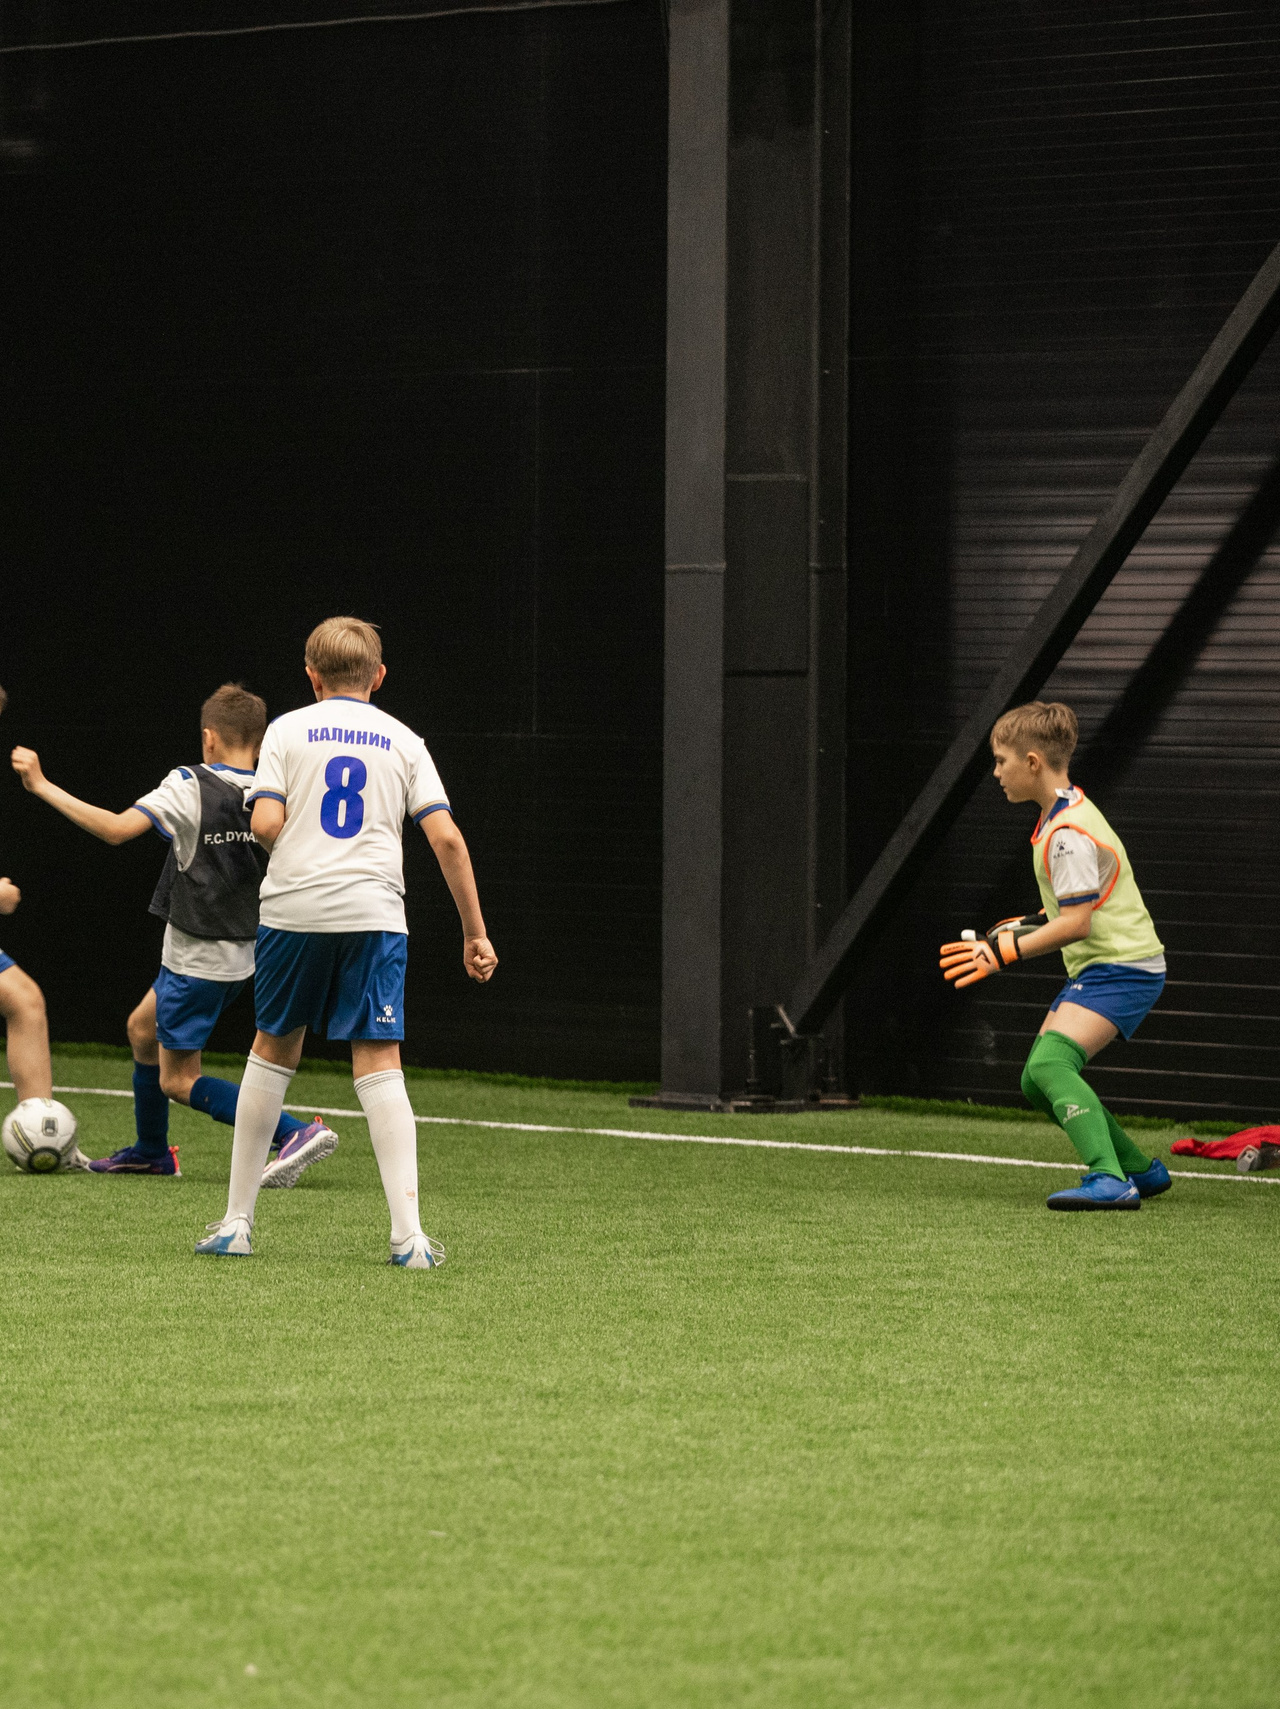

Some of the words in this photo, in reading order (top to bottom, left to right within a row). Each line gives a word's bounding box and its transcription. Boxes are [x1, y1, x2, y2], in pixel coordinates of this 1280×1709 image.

[308, 727, 391, 751] КАЛИНИН
[320, 755, 367, 839] 8
[204, 833, 224, 845] F.C.
[226, 831, 260, 843] DYNA
